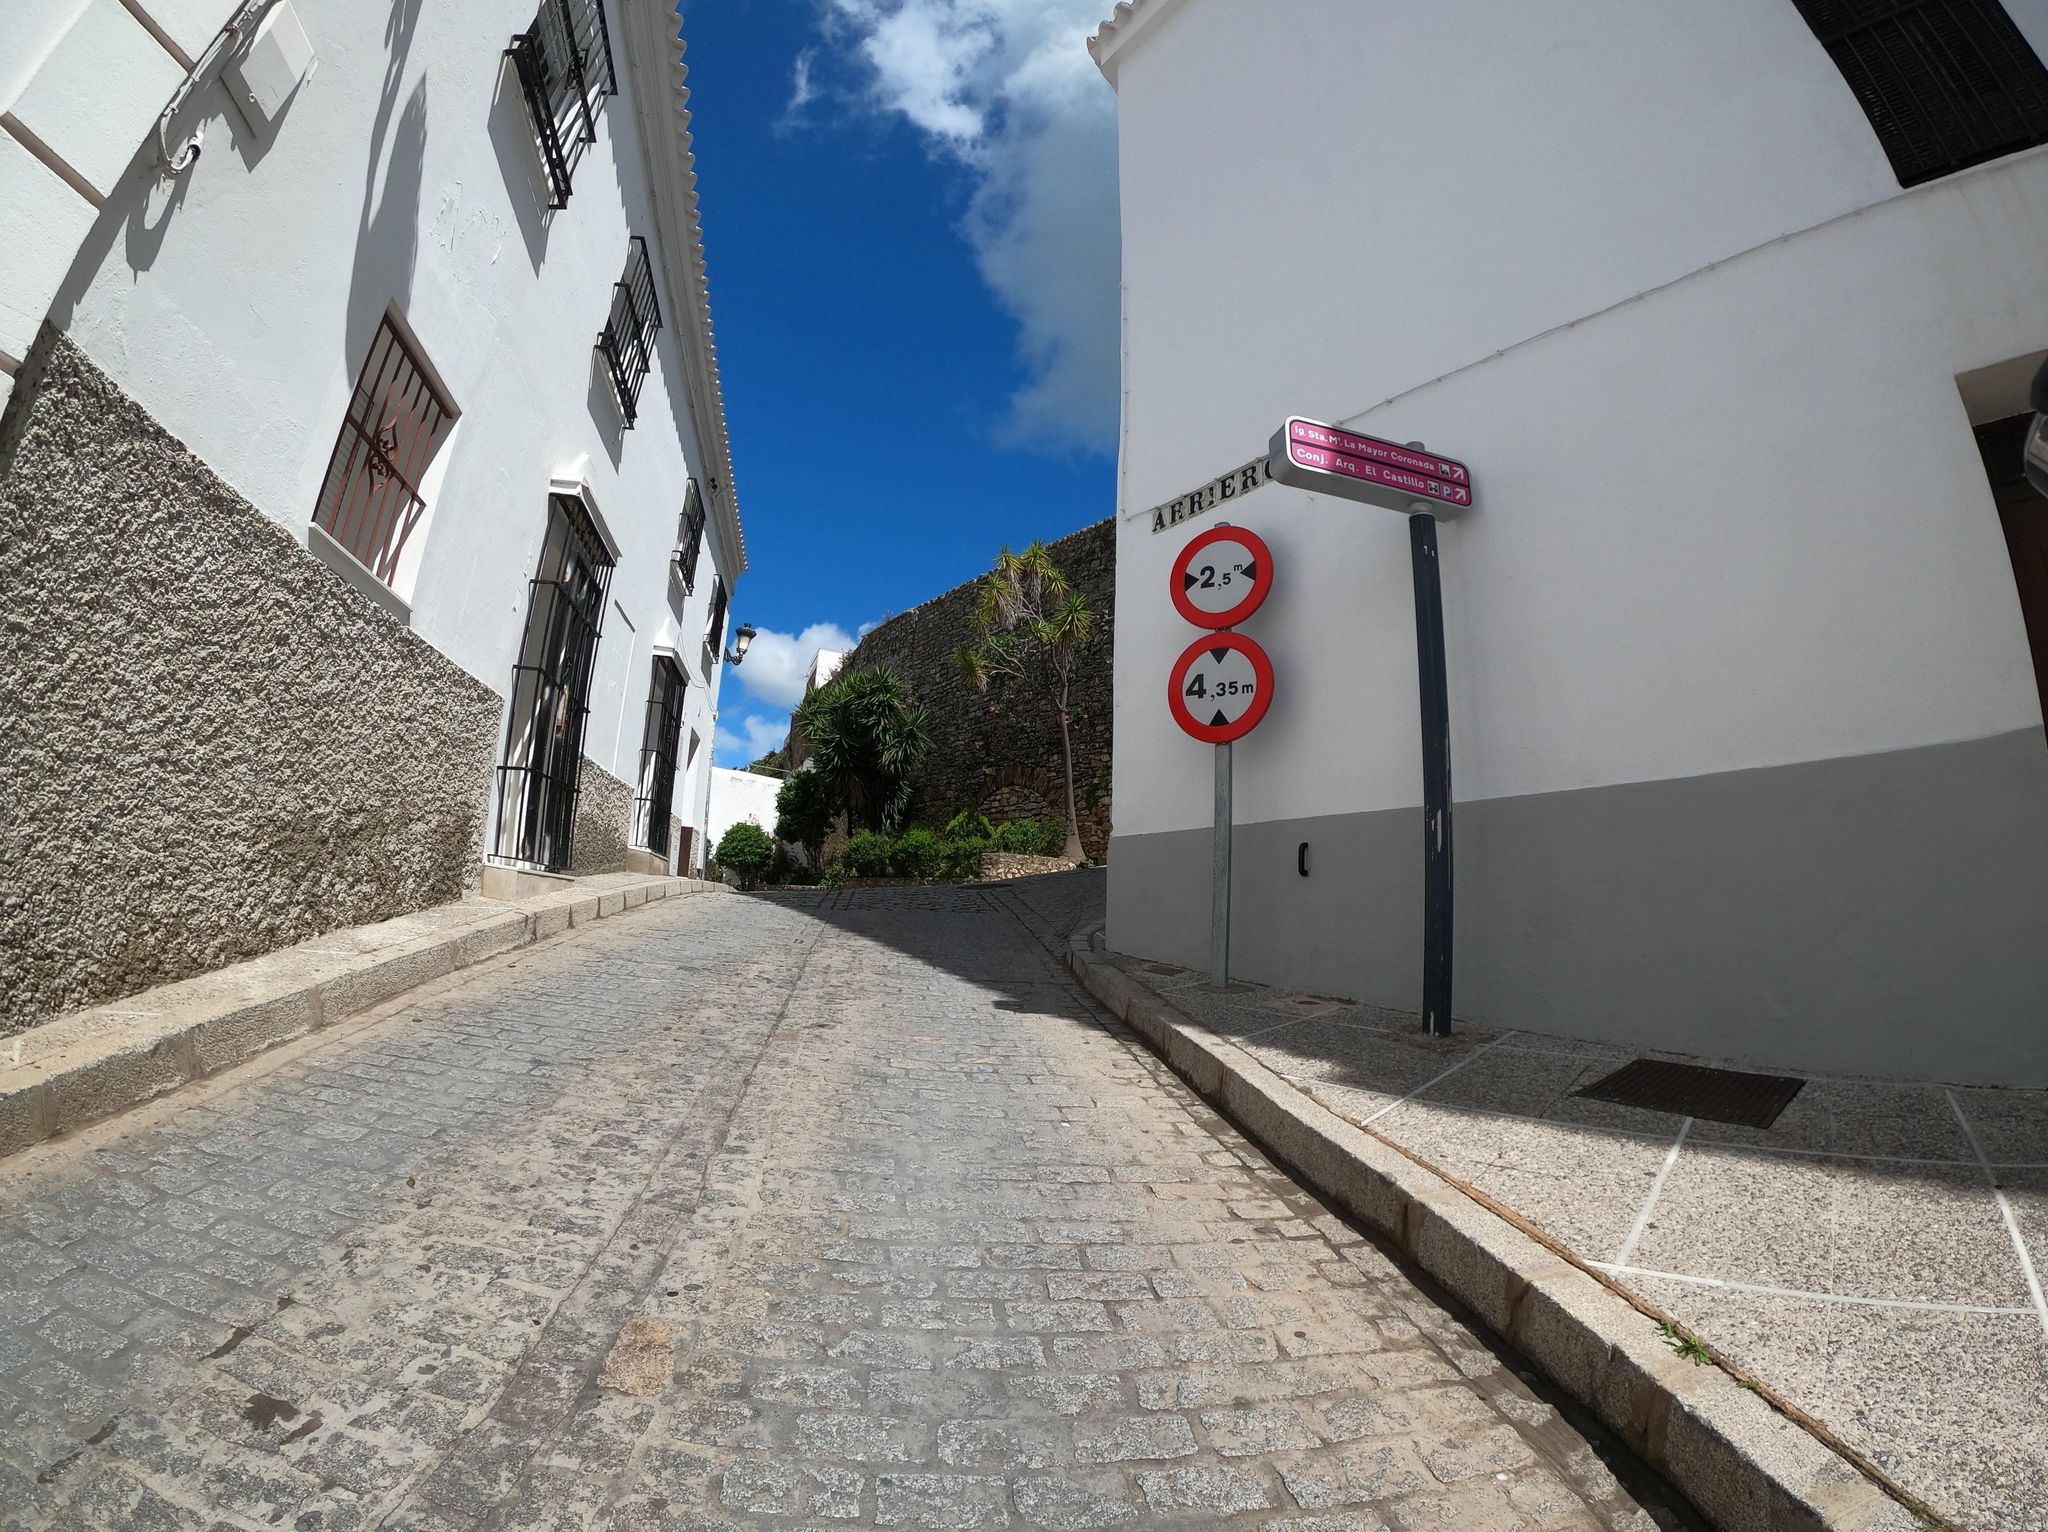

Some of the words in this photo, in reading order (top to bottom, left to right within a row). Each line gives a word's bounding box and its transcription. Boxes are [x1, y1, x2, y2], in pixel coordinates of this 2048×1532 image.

[1296, 448, 1329, 465] Conj.
[1335, 458, 1359, 473] Arq.
[1366, 466, 1377, 476] El
[1383, 470, 1425, 488] Castillo
[1308, 430, 1328, 442] Sta.
[1344, 439, 1356, 449] La
[1358, 443, 1388, 457] Mayor
[1391, 452, 1434, 470] Coronada
